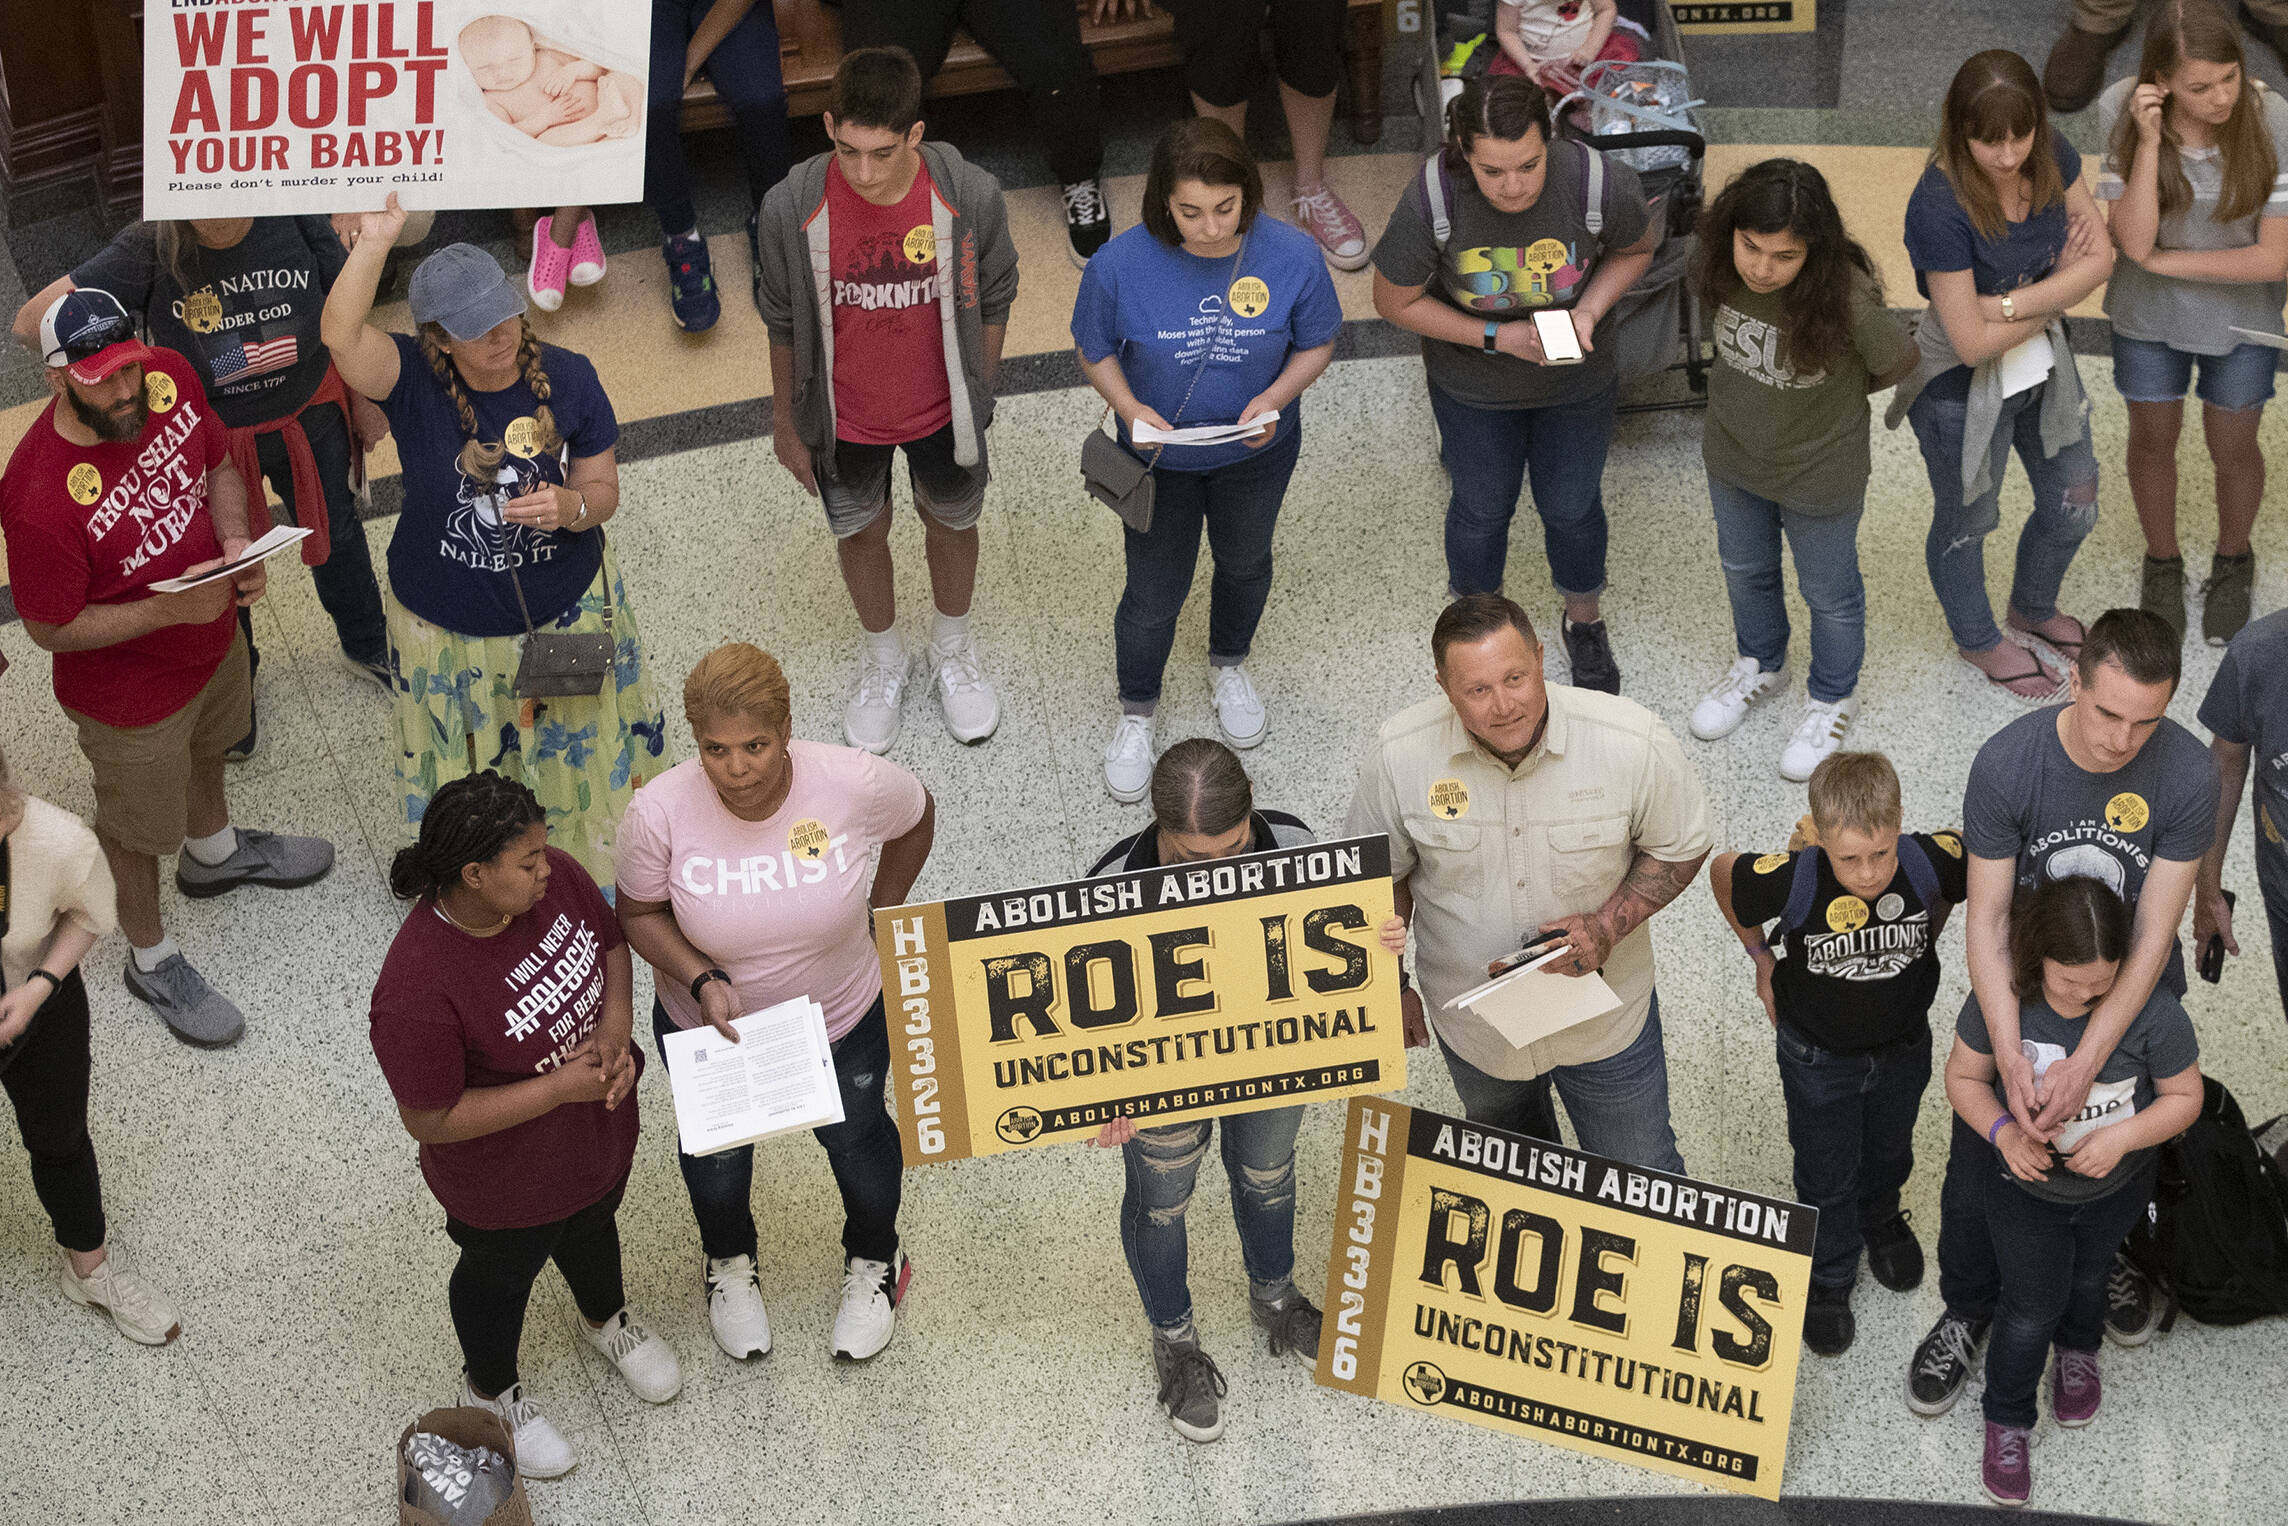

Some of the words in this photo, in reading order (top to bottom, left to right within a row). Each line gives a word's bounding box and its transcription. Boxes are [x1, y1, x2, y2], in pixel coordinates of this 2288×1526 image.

[173, 9, 270, 67] WE
[290, 0, 449, 62] WILL
[168, 59, 449, 135] ADOPT
[168, 136, 290, 174] YOUR
[311, 130, 445, 169] BABY!
[168, 181, 222, 192] Please
[230, 178, 274, 190] don't
[281, 177, 338, 187] murder
[347, 175, 384, 187] your
[392, 172, 444, 184] child!
[904, 237, 937, 251] ABORTIO
[1527, 249, 1564, 263] ABORTION
[220, 269, 310, 296] NATION
[1230, 290, 1268, 304] ABORTION
[258, 303, 292, 321] GOD
[1158, 330, 1187, 340] Moses
[1187, 328, 1205, 338] was
[1234, 328, 1266, 339] person
[223, 382, 262, 396] SINCE
[512, 422, 536, 432] ABOLIS
[72, 466, 97, 501] ABORTION
[128, 453, 193, 536] NOT
[87, 466, 141, 542] THOU
[440, 539, 524, 573] NAILED
[531, 545, 558, 563] IT
[1430, 791, 1469, 808] ABORTION
[1434, 781, 1460, 794] ABOLISH
[793, 820, 818, 837] ABOLISH
[2079, 819, 2096, 827] AM
[2111, 798, 2142, 830] ABORTION
[790, 828, 829, 852] ABORTION
[2029, 827, 2150, 874] ABOLITIONIS
[681, 833, 849, 896] CHRIST
[974, 879, 1143, 932] ABOLISH
[1158, 845, 1363, 905] ABORTION
[1829, 907, 1868, 923] ABORTION
[538, 913, 573, 957] NEVER
[1812, 923, 1929, 961] ABOLITIONIST
[504, 920, 600, 1043] APOLOGIZE
[504, 976, 519, 993] I
[510, 952, 548, 985] WILL
[979, 926, 1216, 1043] ROE
[1259, 904, 1371, 1001] IS
[548, 1011, 576, 1043] FOR
[573, 974, 603, 1019] BEING
[992, 1005, 1376, 1089] UNCONSTITUTIONAL
[1053, 1066, 1365, 1127] ABOLISHABORTIONTX.ORG
[1431, 1124, 1589, 1193] ABOLISH
[1597, 1168, 1790, 1243] ABORTION
[1418, 1185, 1638, 1335] ROE
[1671, 1251, 1781, 1370] IS
[1414, 1304, 1765, 1424] UNCONSTITUTIONAL
[1453, 1387, 1744, 1473] ABOLISHABORTIONTX.ORG
